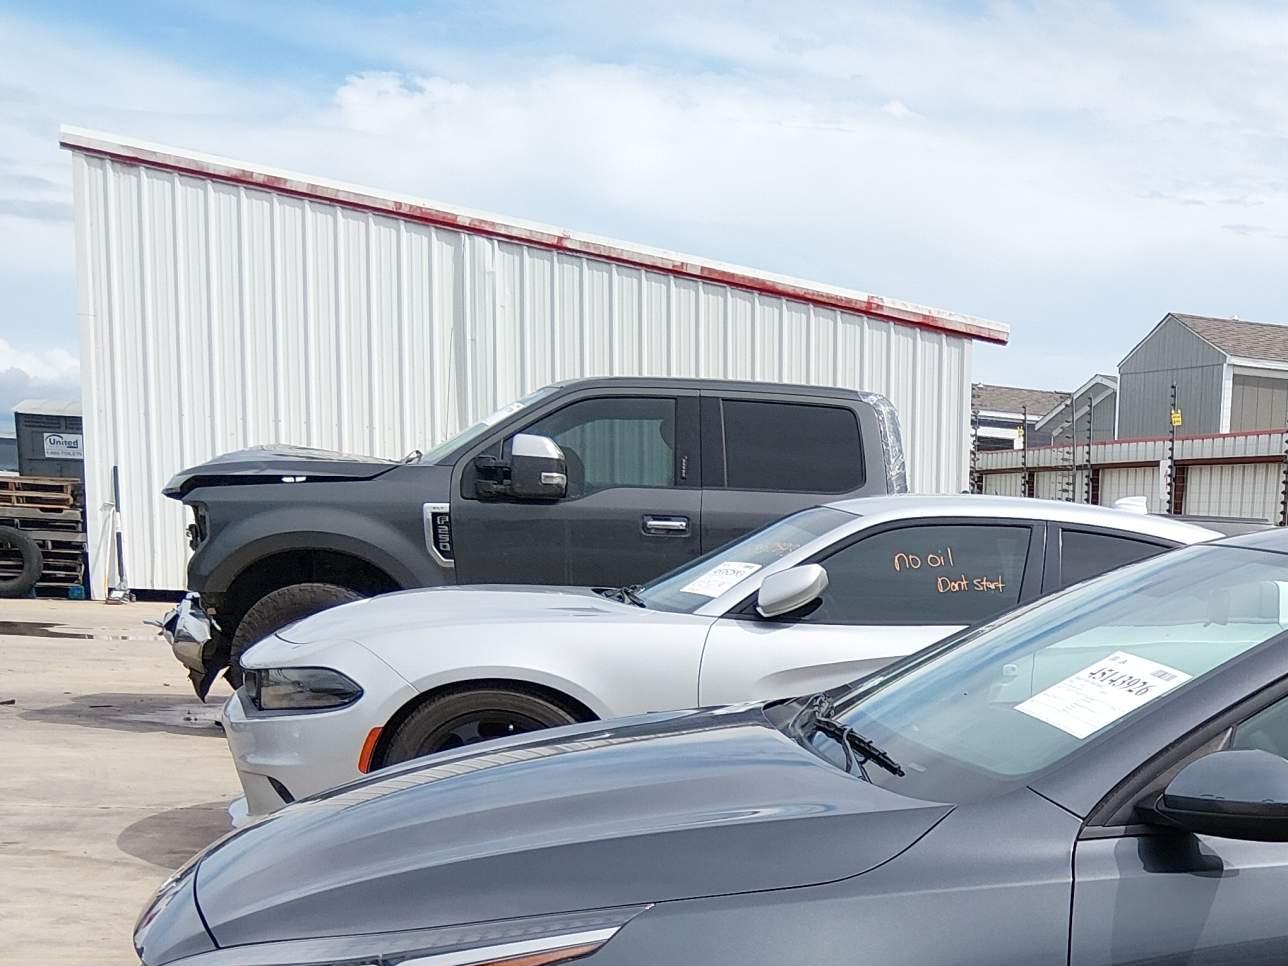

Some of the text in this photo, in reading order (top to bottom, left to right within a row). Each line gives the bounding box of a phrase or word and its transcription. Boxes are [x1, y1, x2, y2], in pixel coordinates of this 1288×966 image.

[48, 437, 79, 447] United
[927, 546, 954, 567] oil
[1088, 666, 1154, 697] 45143926
